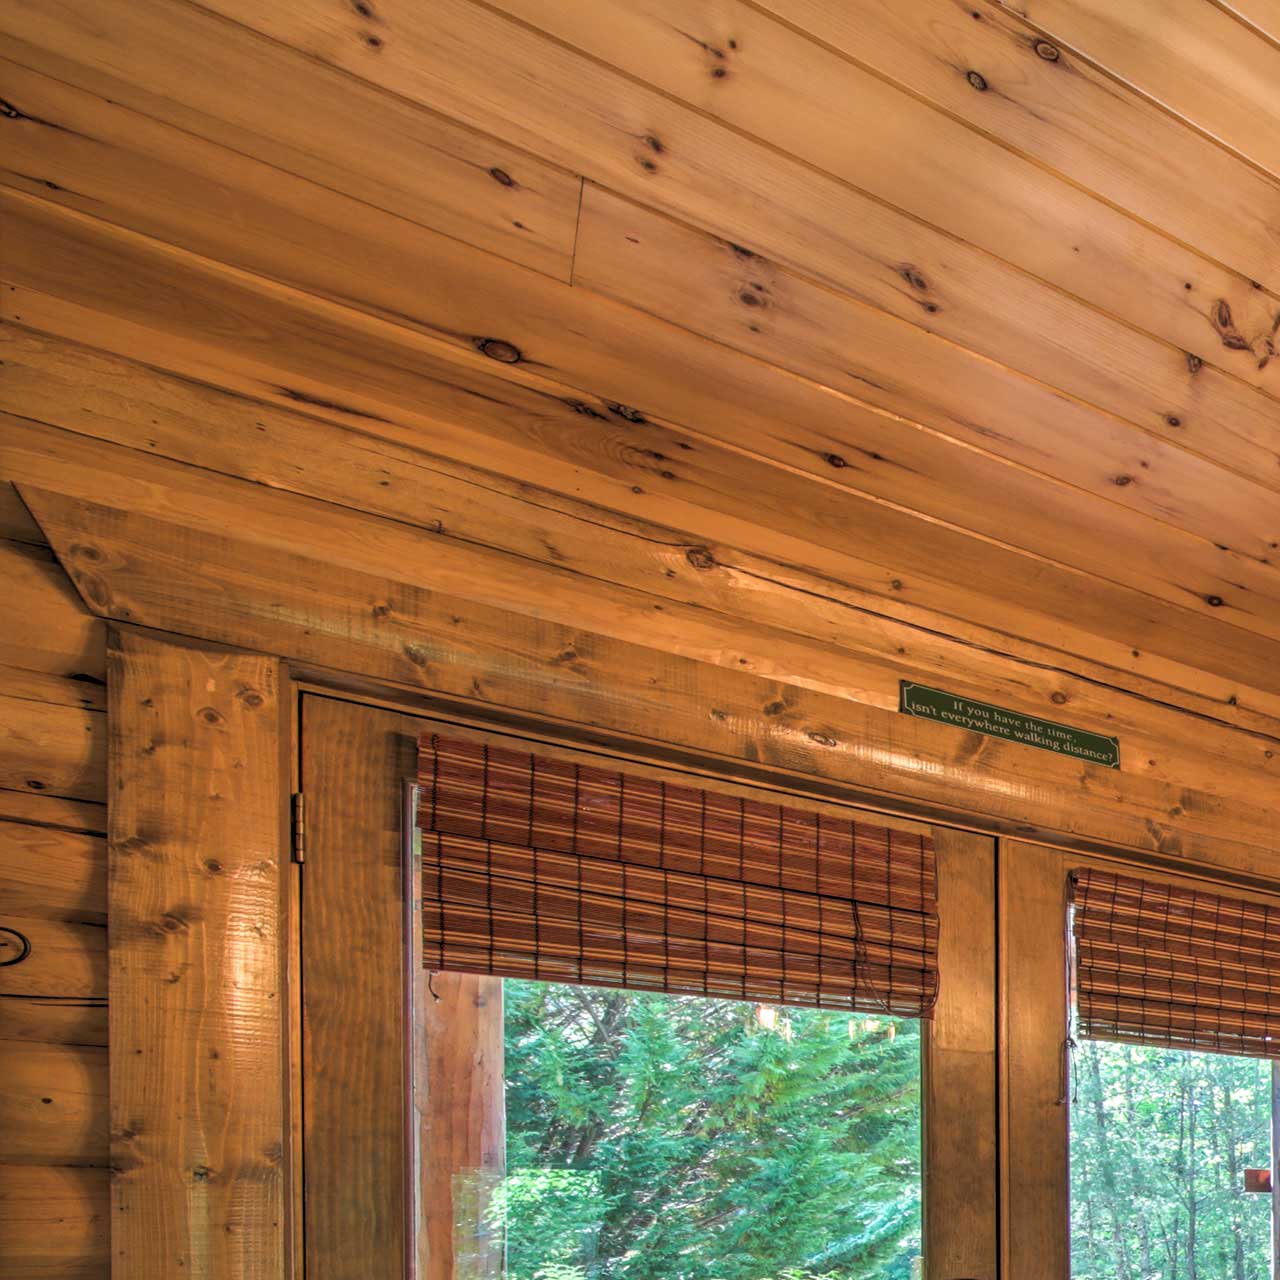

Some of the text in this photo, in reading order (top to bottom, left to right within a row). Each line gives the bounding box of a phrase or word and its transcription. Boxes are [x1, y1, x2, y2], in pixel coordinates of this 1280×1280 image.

[912, 702, 1113, 762] isn't everywhere walking distance?
[953, 700, 963, 712] If
[967, 704, 989, 718] you
[994, 711, 1021, 727] have
[1025, 721, 1043, 733] the
